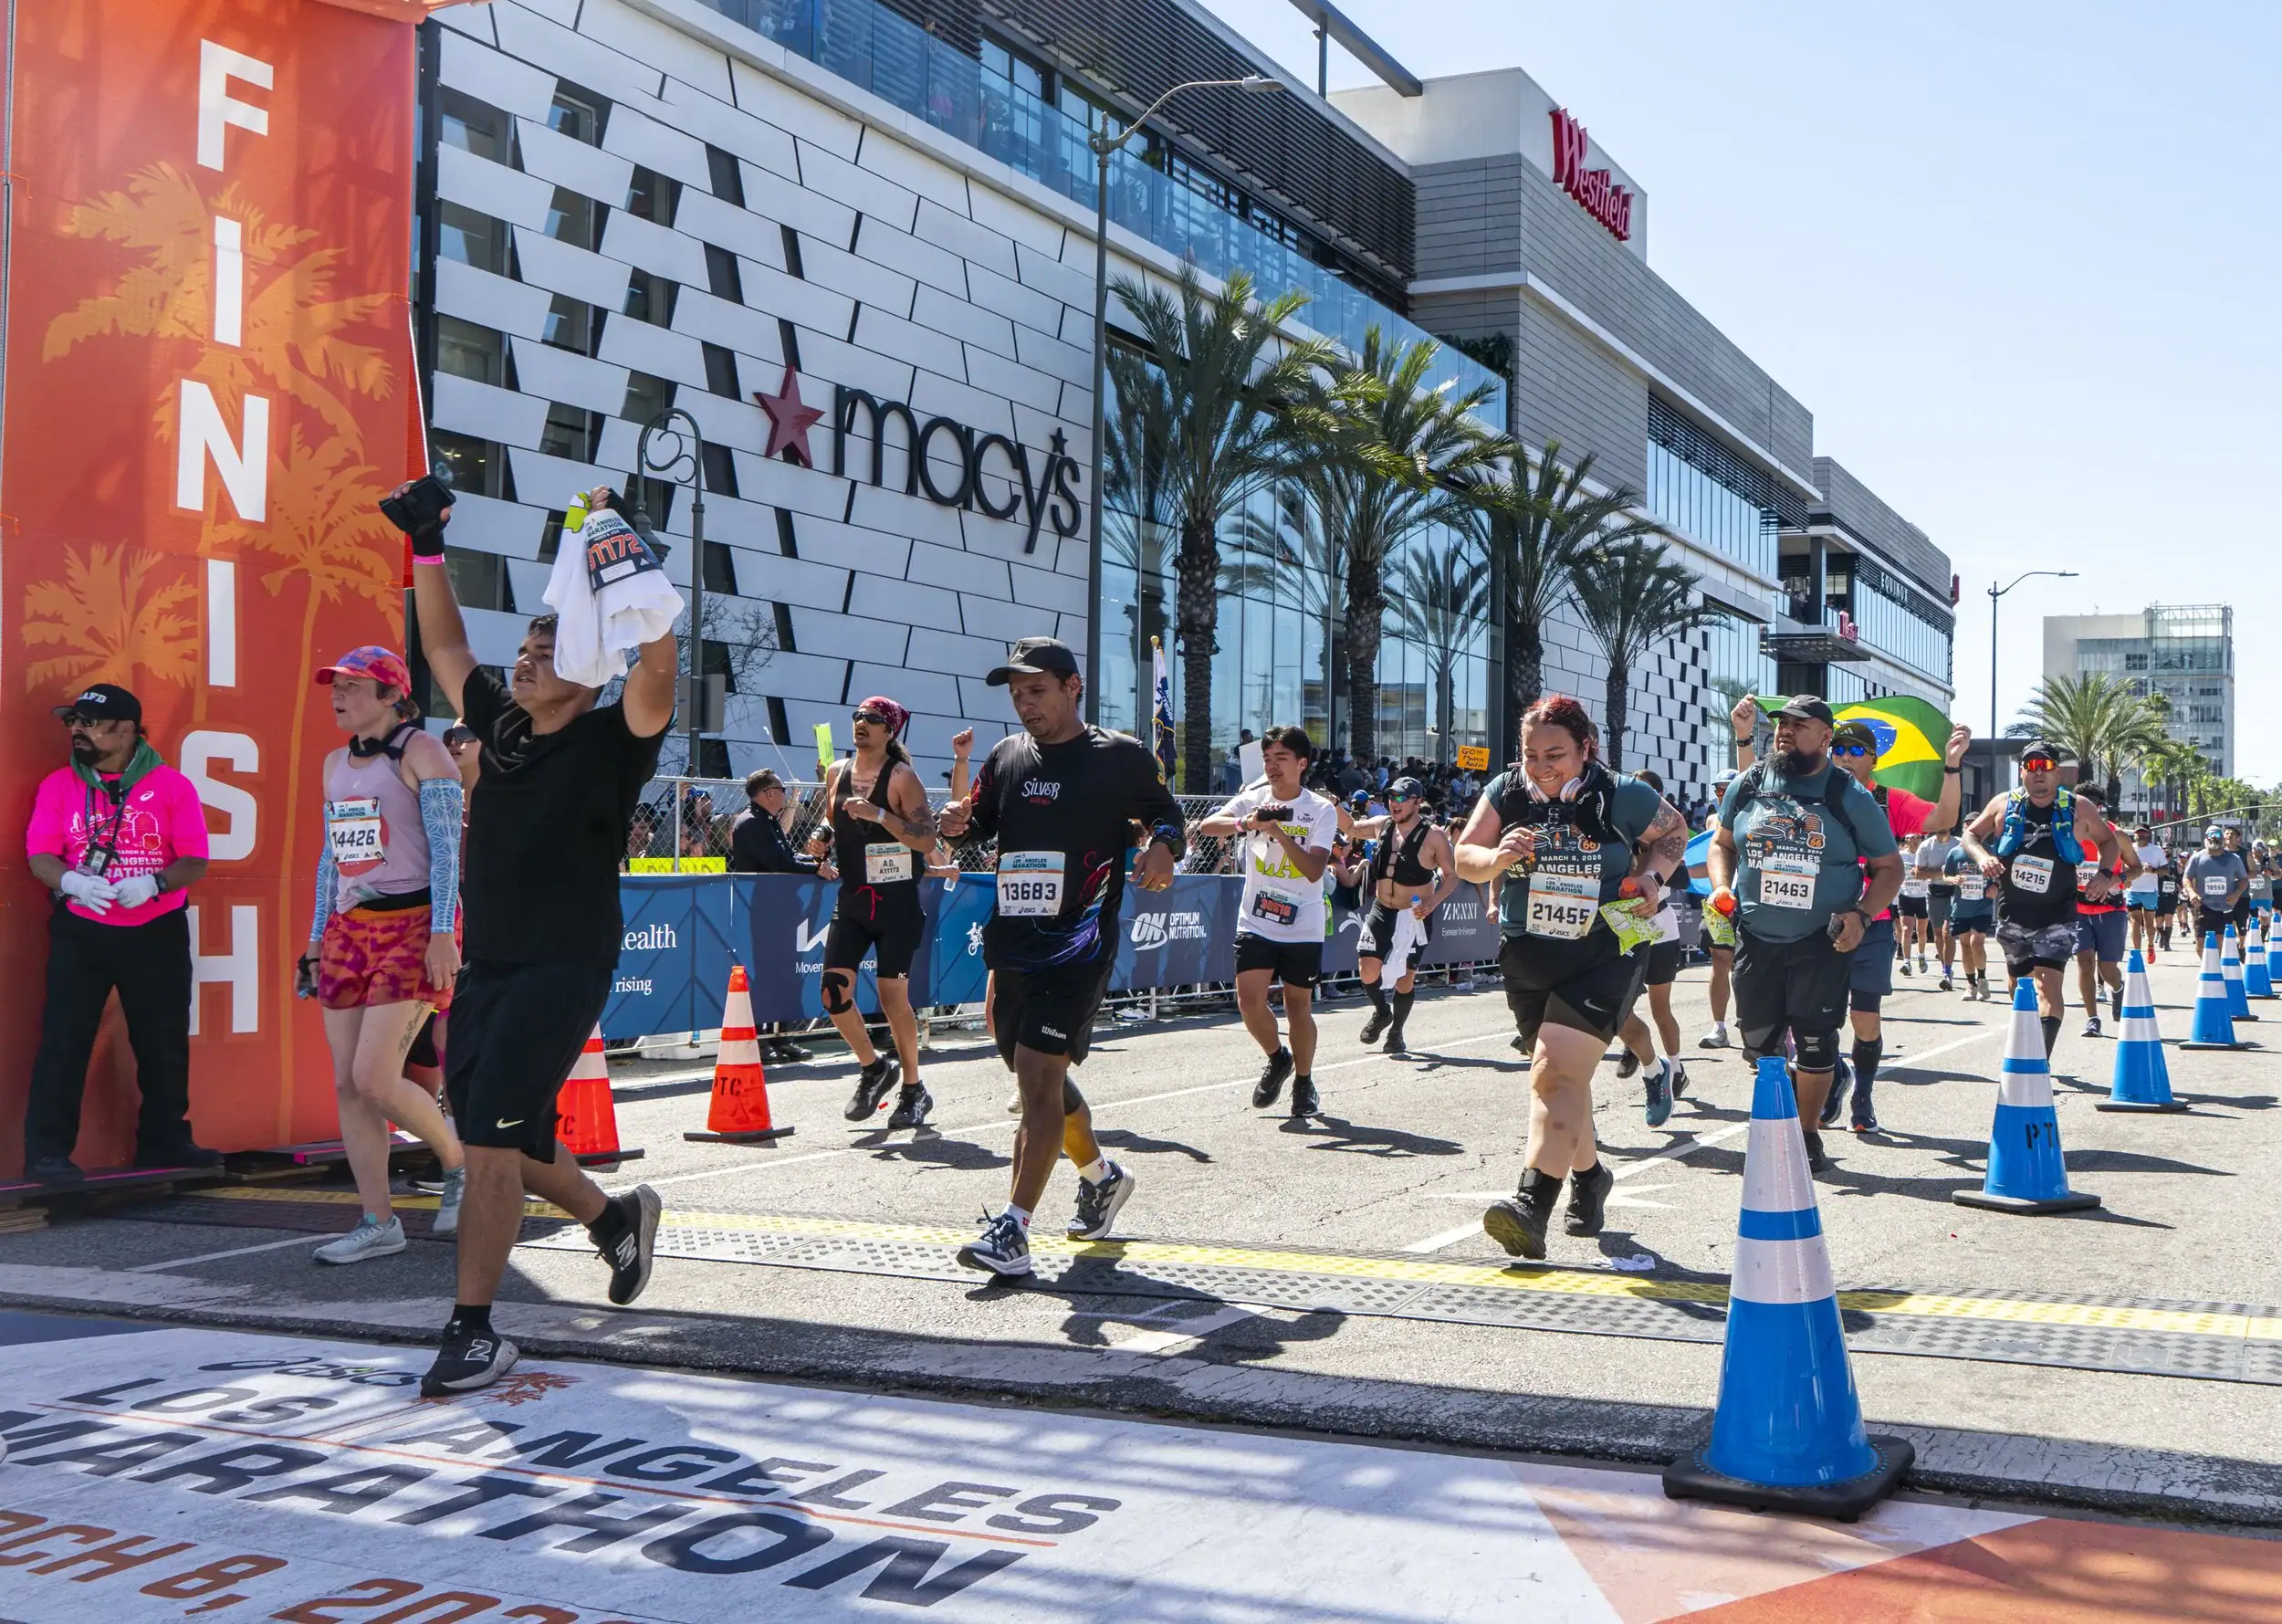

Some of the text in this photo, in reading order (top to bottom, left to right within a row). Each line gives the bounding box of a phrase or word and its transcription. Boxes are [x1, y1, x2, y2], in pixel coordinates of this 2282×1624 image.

[1549, 107, 1634, 241] Westfield
[176, 38, 274, 1035] FINISH
[332, 829, 375, 848] 14426
[1582, 841, 1596, 850] 66
[1811, 839, 1822, 847] 66
[1747, 849, 1821, 864] LOS ANGELES
[1537, 863, 1602, 874] ANGELES
[2015, 869, 2046, 885] 14215
[1002, 882, 1057, 901] 13683
[1545, 885, 1583, 894] MARATHON
[1764, 880, 1809, 897] 21463
[1169, 911, 1199, 927] OPTIMUM
[1442, 902, 1478, 921] ZENNI
[1533, 902, 1590, 925] 21455
[621, 924, 677, 950] ealth
[615, 976, 653, 996] rising
[59, 1378, 1123, 1535] LOS ANGELES
[0, 1410, 1028, 1608] MARATHON
[139, 1554, 289, 1616] 8,
